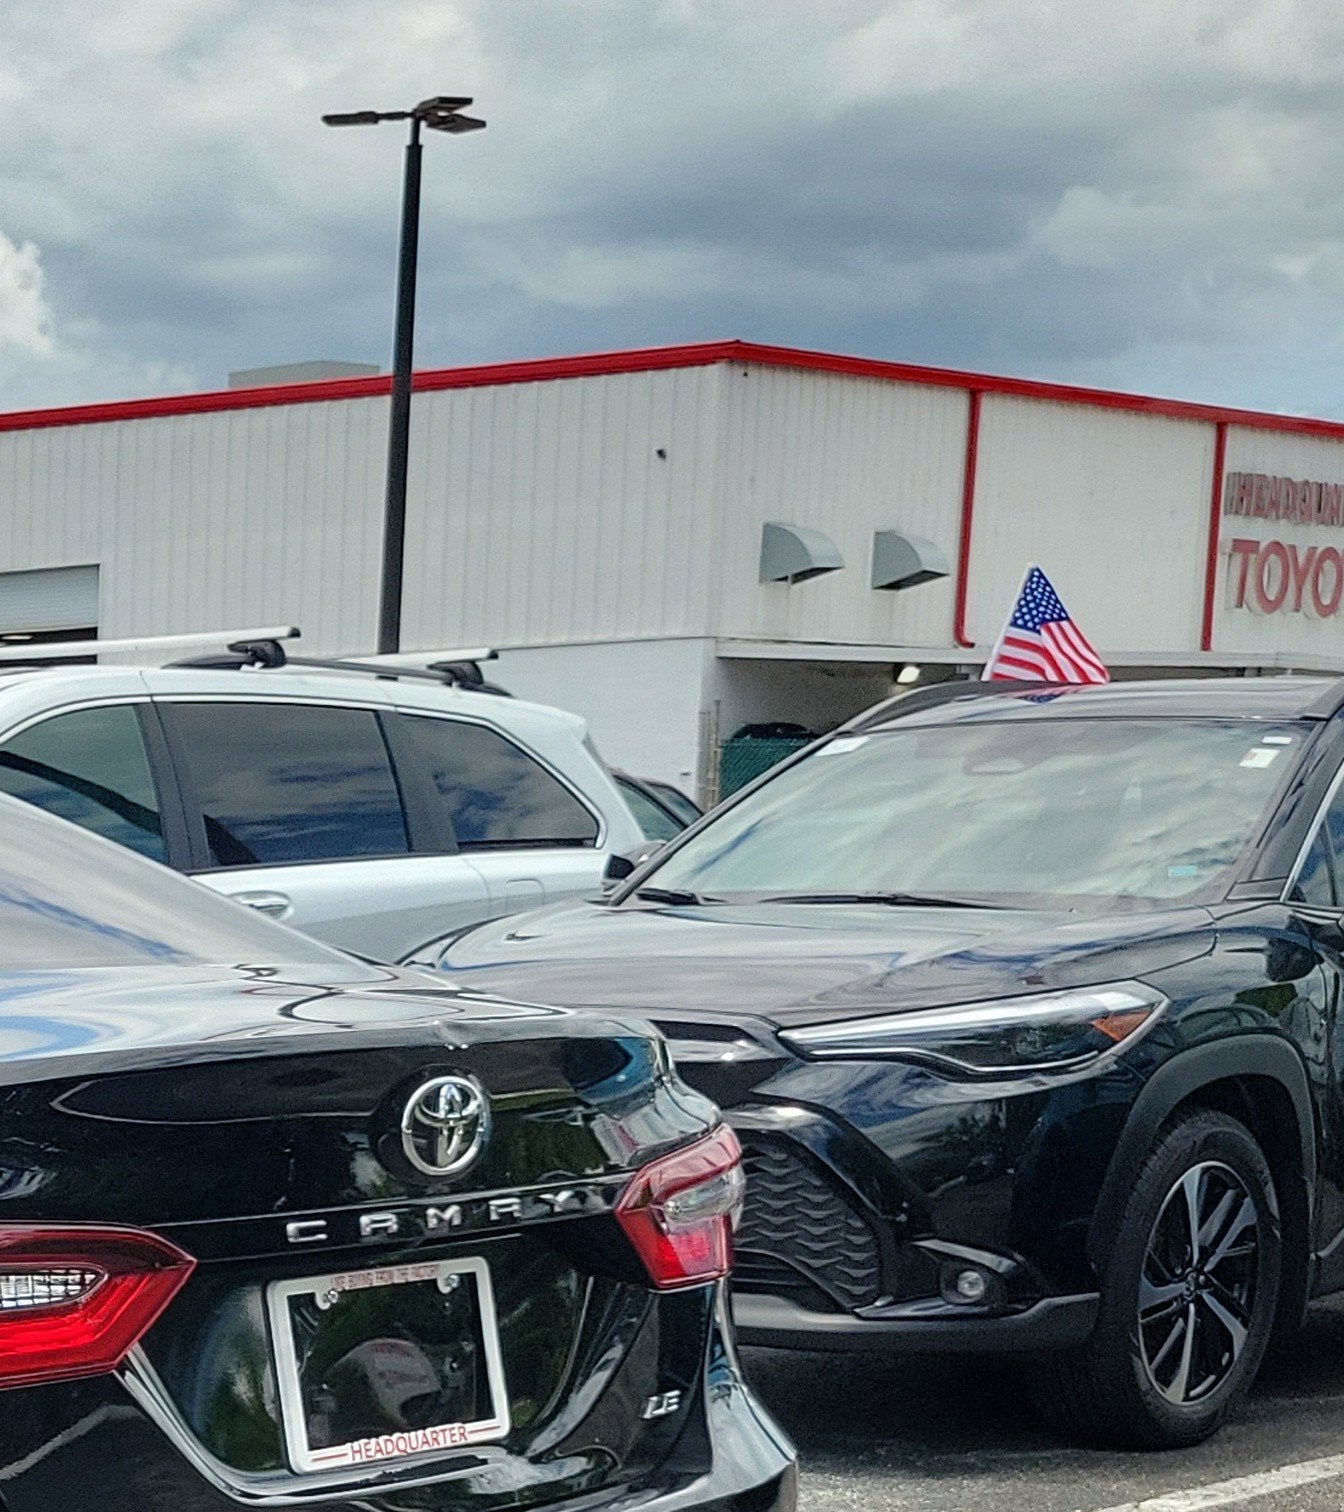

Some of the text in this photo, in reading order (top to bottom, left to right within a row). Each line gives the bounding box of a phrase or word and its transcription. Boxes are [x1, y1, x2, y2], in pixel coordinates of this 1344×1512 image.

[1231, 538, 1344, 619] TOYO
[286, 1189, 576, 1243] CAMRY
[640, 1390, 682, 1419] LE
[349, 1425, 469, 1462] HEADQUARTER
